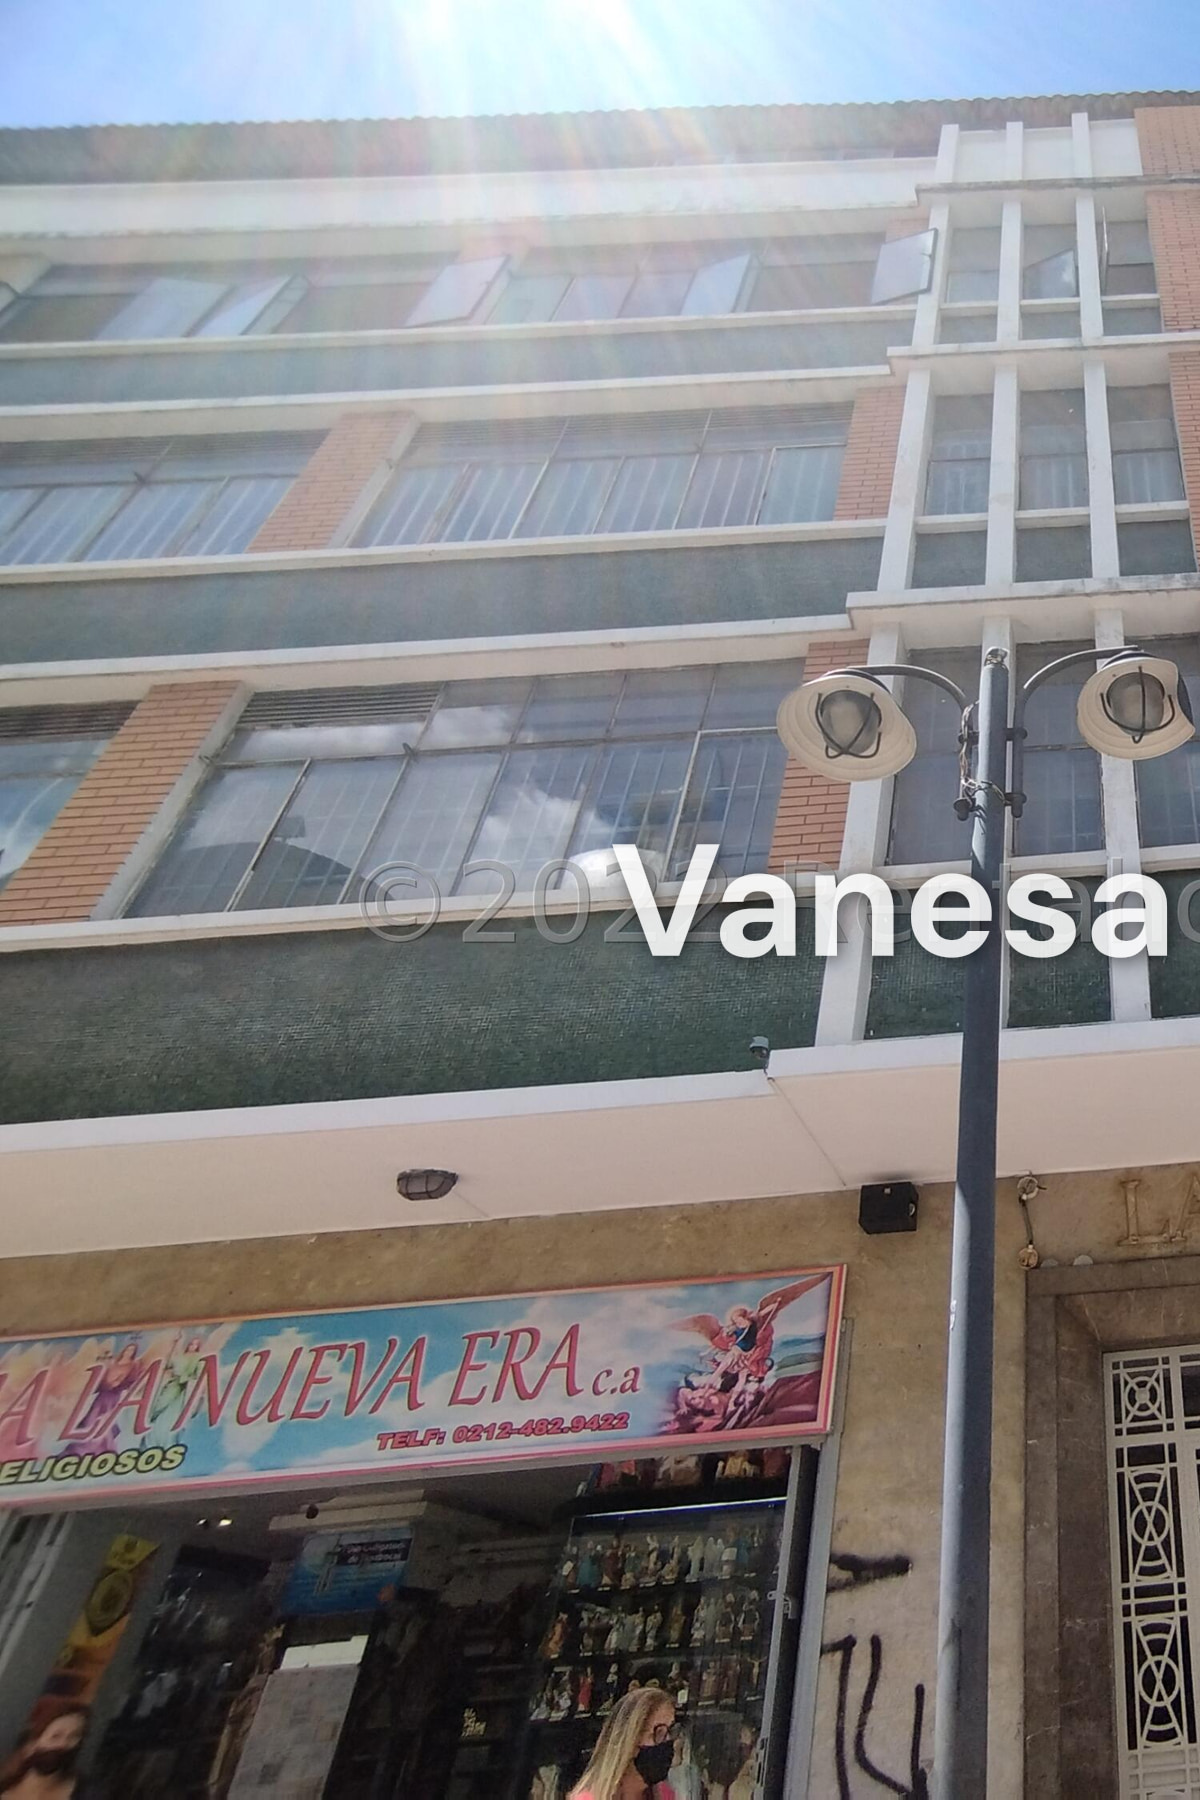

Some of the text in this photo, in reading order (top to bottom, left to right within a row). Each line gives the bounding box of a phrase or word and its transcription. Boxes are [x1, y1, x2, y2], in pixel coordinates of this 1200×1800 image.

[0, 1323, 641, 1446] A LA NUEVA ERA c.a
[377, 1412, 630, 1451] TELF: 0212-482.9422
